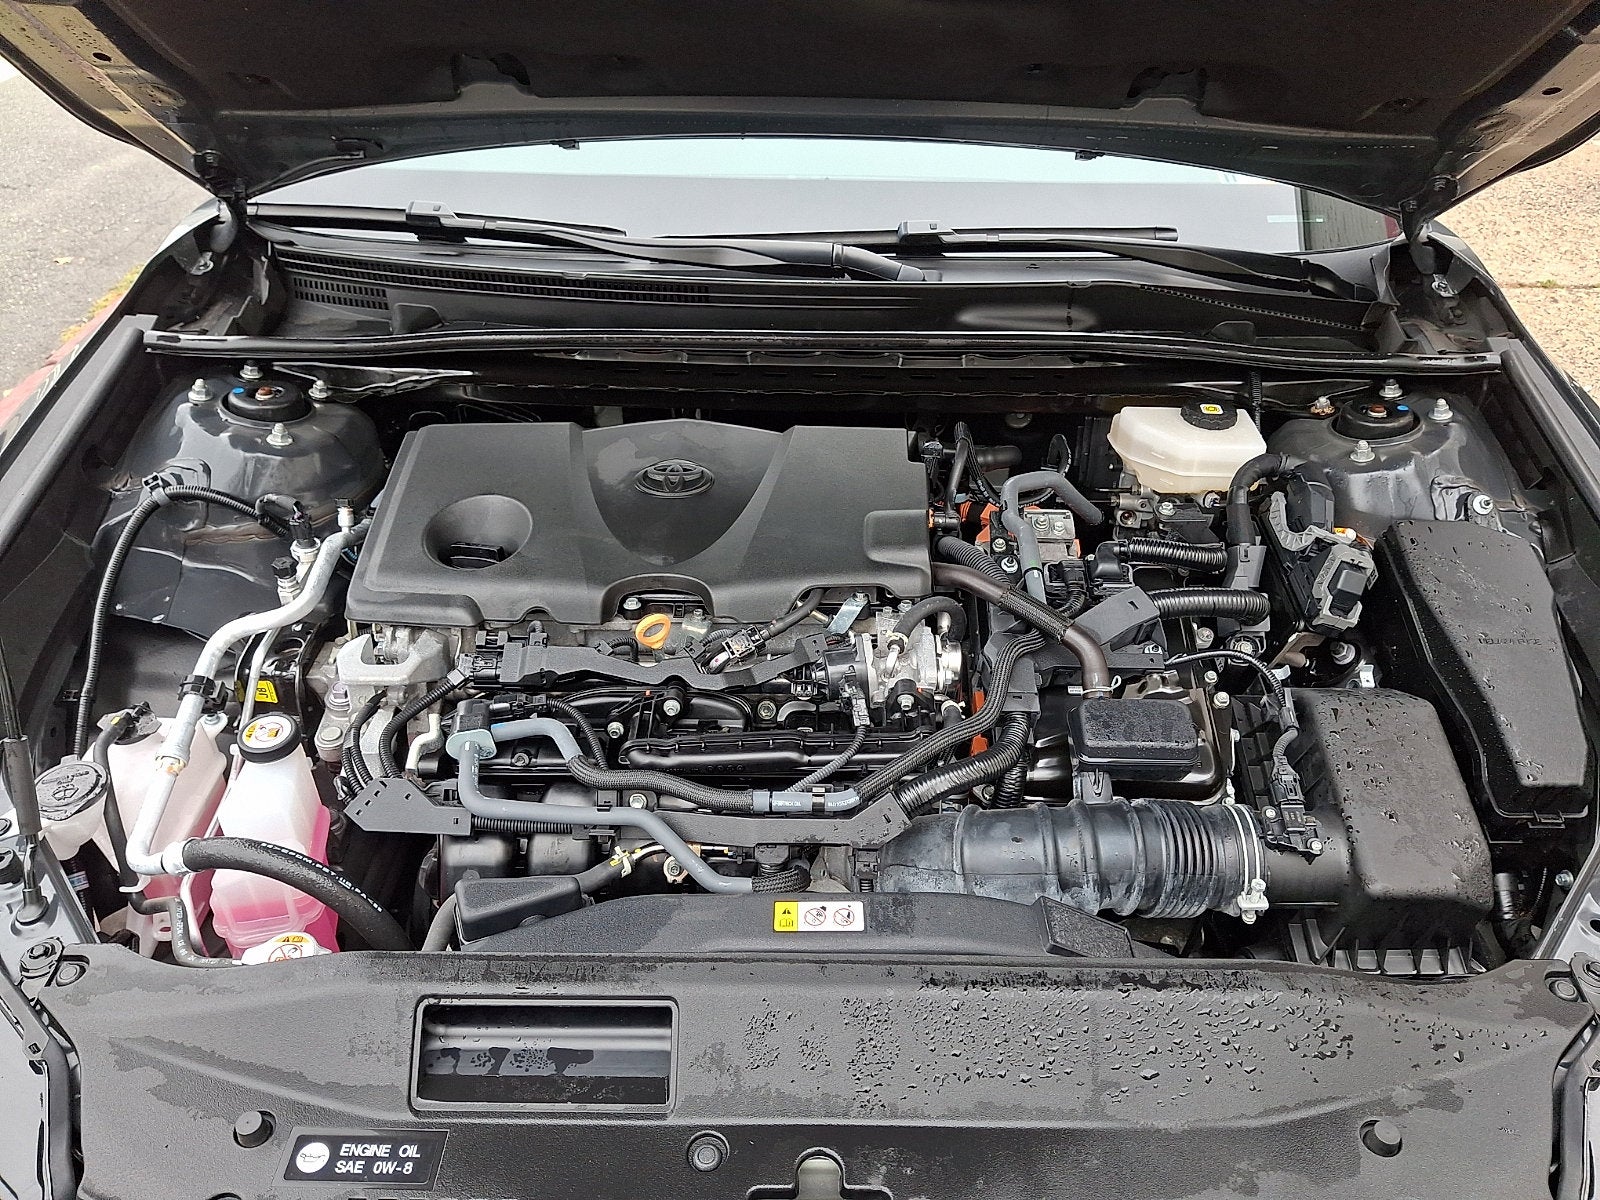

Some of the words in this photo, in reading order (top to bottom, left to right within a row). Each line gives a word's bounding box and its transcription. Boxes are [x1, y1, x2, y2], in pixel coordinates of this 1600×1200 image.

[339, 1144, 391, 1158] ENGINE
[398, 1144, 421, 1158] OIL
[334, 1161, 365, 1174] SAE
[372, 1161, 413, 1175] 0W-8
